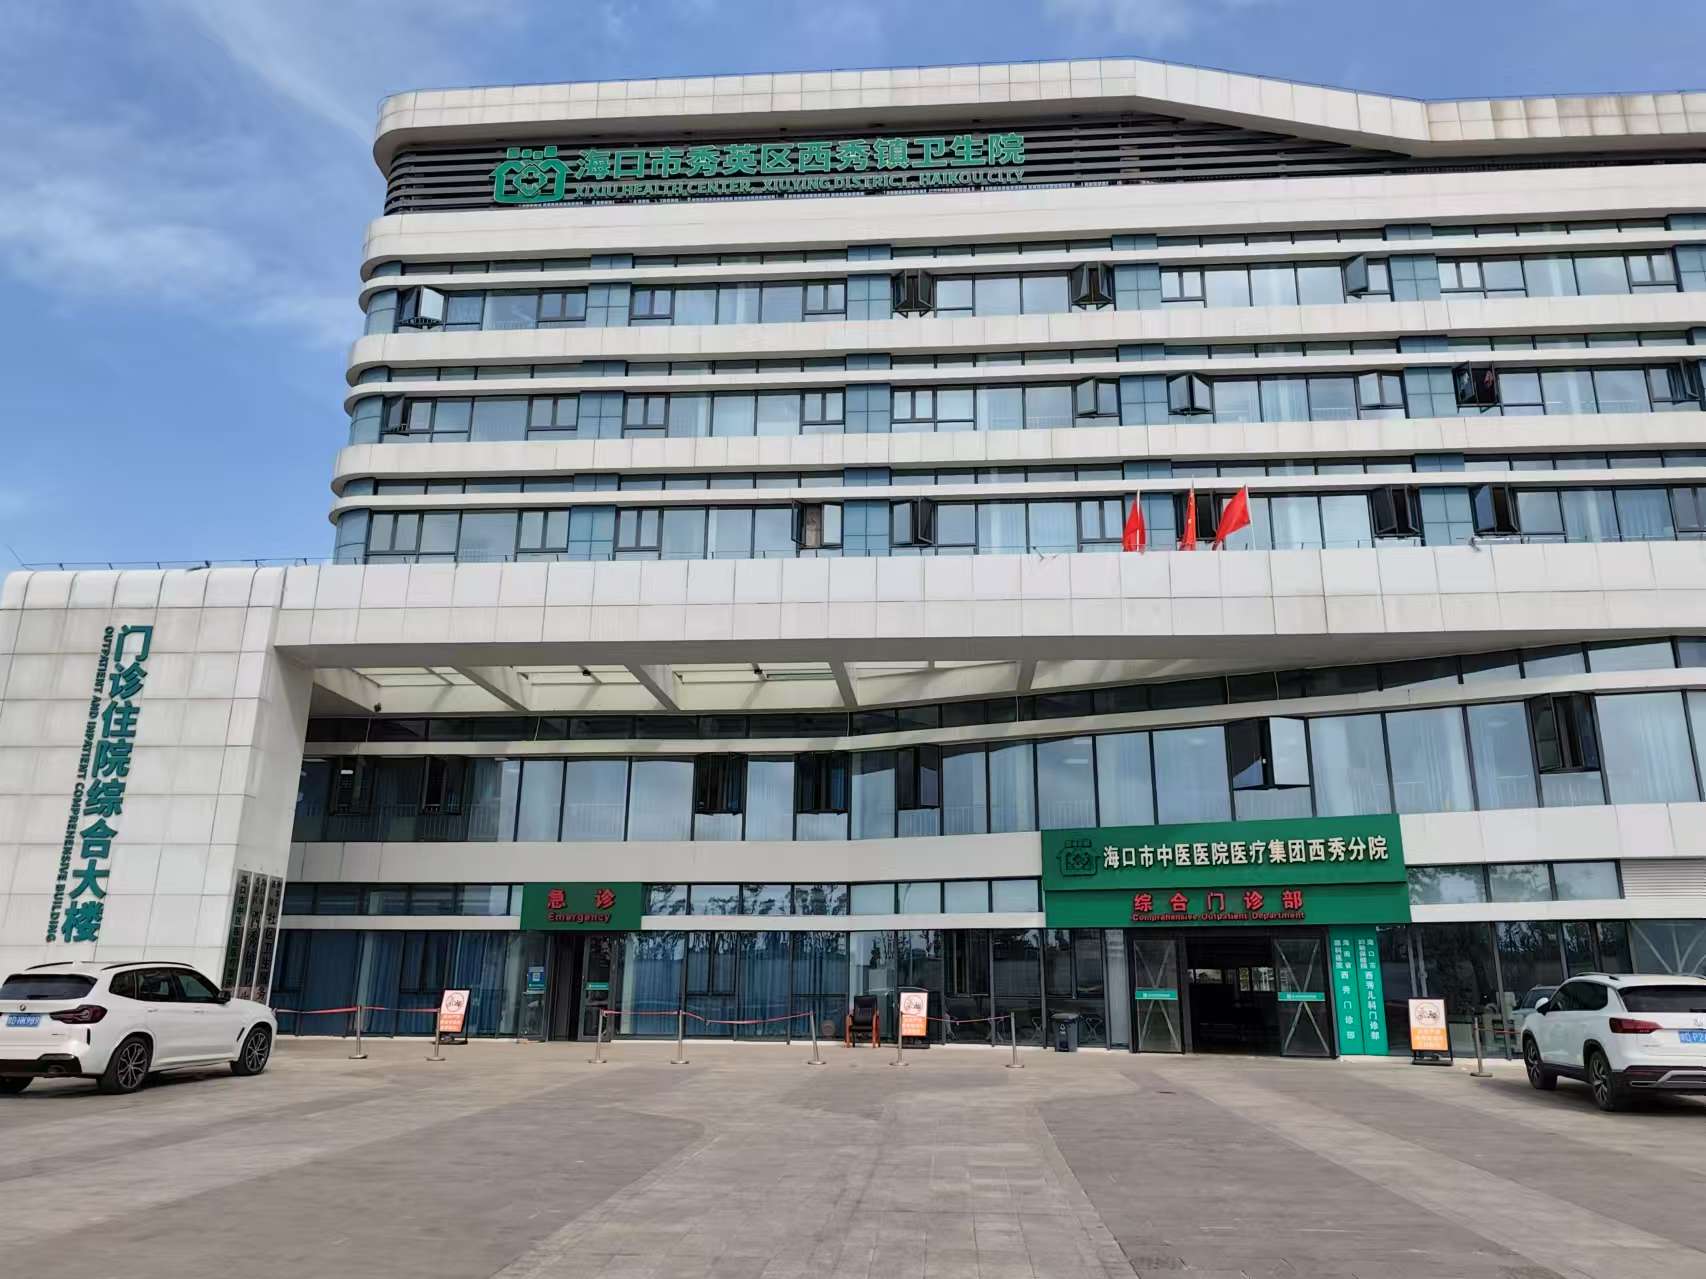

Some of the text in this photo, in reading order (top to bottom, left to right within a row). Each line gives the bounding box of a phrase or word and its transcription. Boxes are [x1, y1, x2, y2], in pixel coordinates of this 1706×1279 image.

[575, 132, 1025, 180] 海口市秀英区西秀镇卫生院
[575, 185, 617, 198] XIXIU
[622, 182, 683, 197] HEALTH
[763, 176, 830, 192] XIUYING
[919, 170, 983, 187] HAIKOU
[987, 169, 1025, 184] CITY
[46, 626, 115, 943] OUTPATIENT AND INPATIENT COMPREHENSIVE BUILDING
[61, 624, 154, 943] 门诊住院综合大楼
[1103, 835, 1388, 869] 海口市中医医院医疗集团西秀分院
[547, 888, 616, 909] 急诊
[1133, 890, 1304, 912] 综合门诊部
[548, 912, 611, 923] Emergency
[1132, 911, 1305, 921] Comprehensive Outpatient Department
[1341, 971, 1355, 1040] 西秀门诊部
[1365, 971, 1380, 1041] 西秀儿科门诊部
